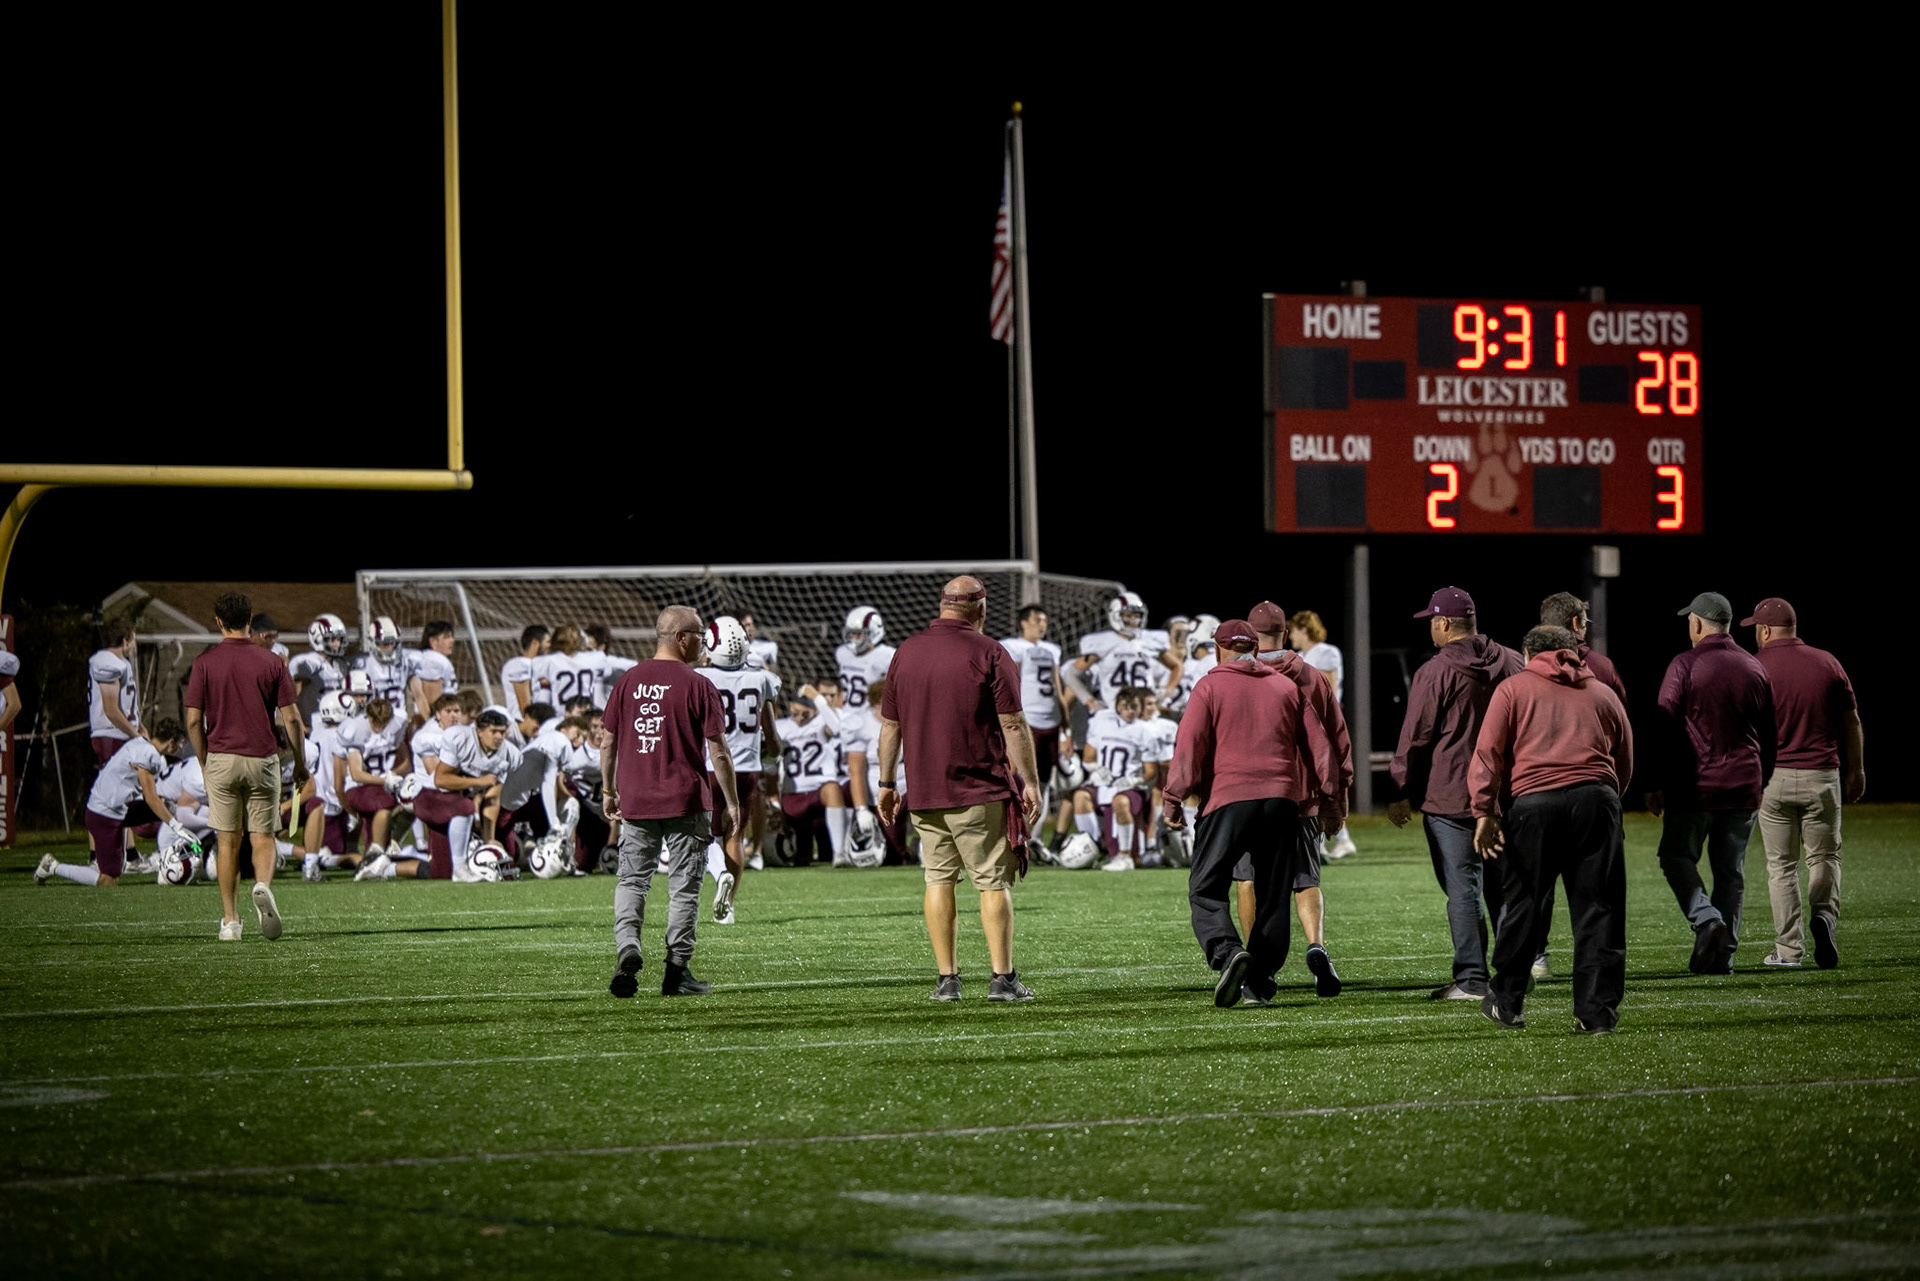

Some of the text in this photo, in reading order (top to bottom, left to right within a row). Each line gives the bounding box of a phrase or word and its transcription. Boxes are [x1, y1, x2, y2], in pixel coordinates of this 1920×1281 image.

[1303, 305, 1381, 339] HOME
[1454, 304, 1567, 370] 9:31
[1588, 311, 1688, 345] GUESTS
[1418, 375, 1568, 408] LEICESTER
[1635, 351, 1699, 415] 28
[1437, 411, 1545, 424] WOLVERINES
[1290, 435, 1371, 461] BALL ON
[1414, 436, 1471, 462] DOWN
[1518, 437, 1615, 464] YDS TO GO
[1647, 438, 1685, 464] QTR
[1426, 463, 1459, 529] 2
[1656, 465, 1685, 529] 3
[556, 669, 594, 705] 20
[1037, 665, 1055, 697] 5
[1110, 660, 1149, 688] 46
[633, 683, 671, 700] JUST
[639, 702, 660, 715] GO
[634, 715, 666, 734] GET
[637, 735, 662, 754] IT
[1101, 745, 1129, 777] 10
